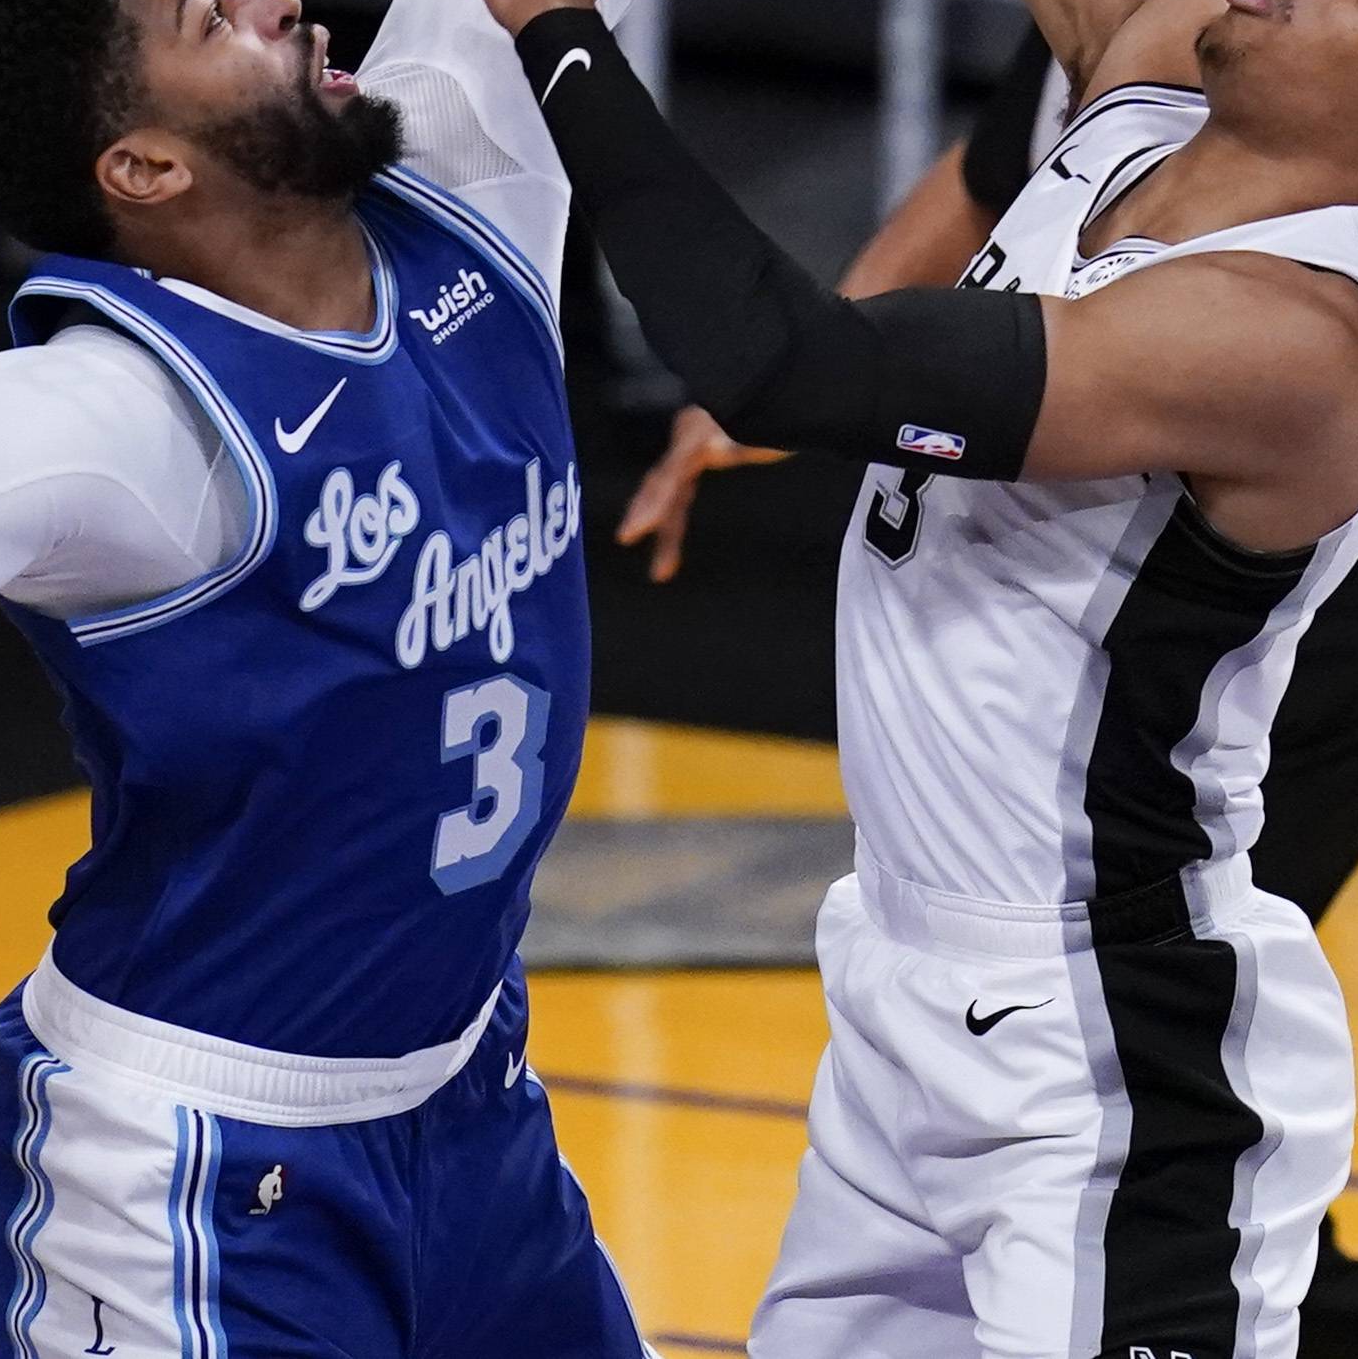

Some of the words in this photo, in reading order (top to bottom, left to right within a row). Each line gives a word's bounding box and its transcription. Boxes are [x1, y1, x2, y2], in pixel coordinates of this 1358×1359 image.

[409, 268, 487, 331] wish
[432, 292, 495, 345] SHOPPING
[299, 460, 420, 612] Los
[395, 456, 582, 669] Angeles
[430, 672, 551, 896] 3
